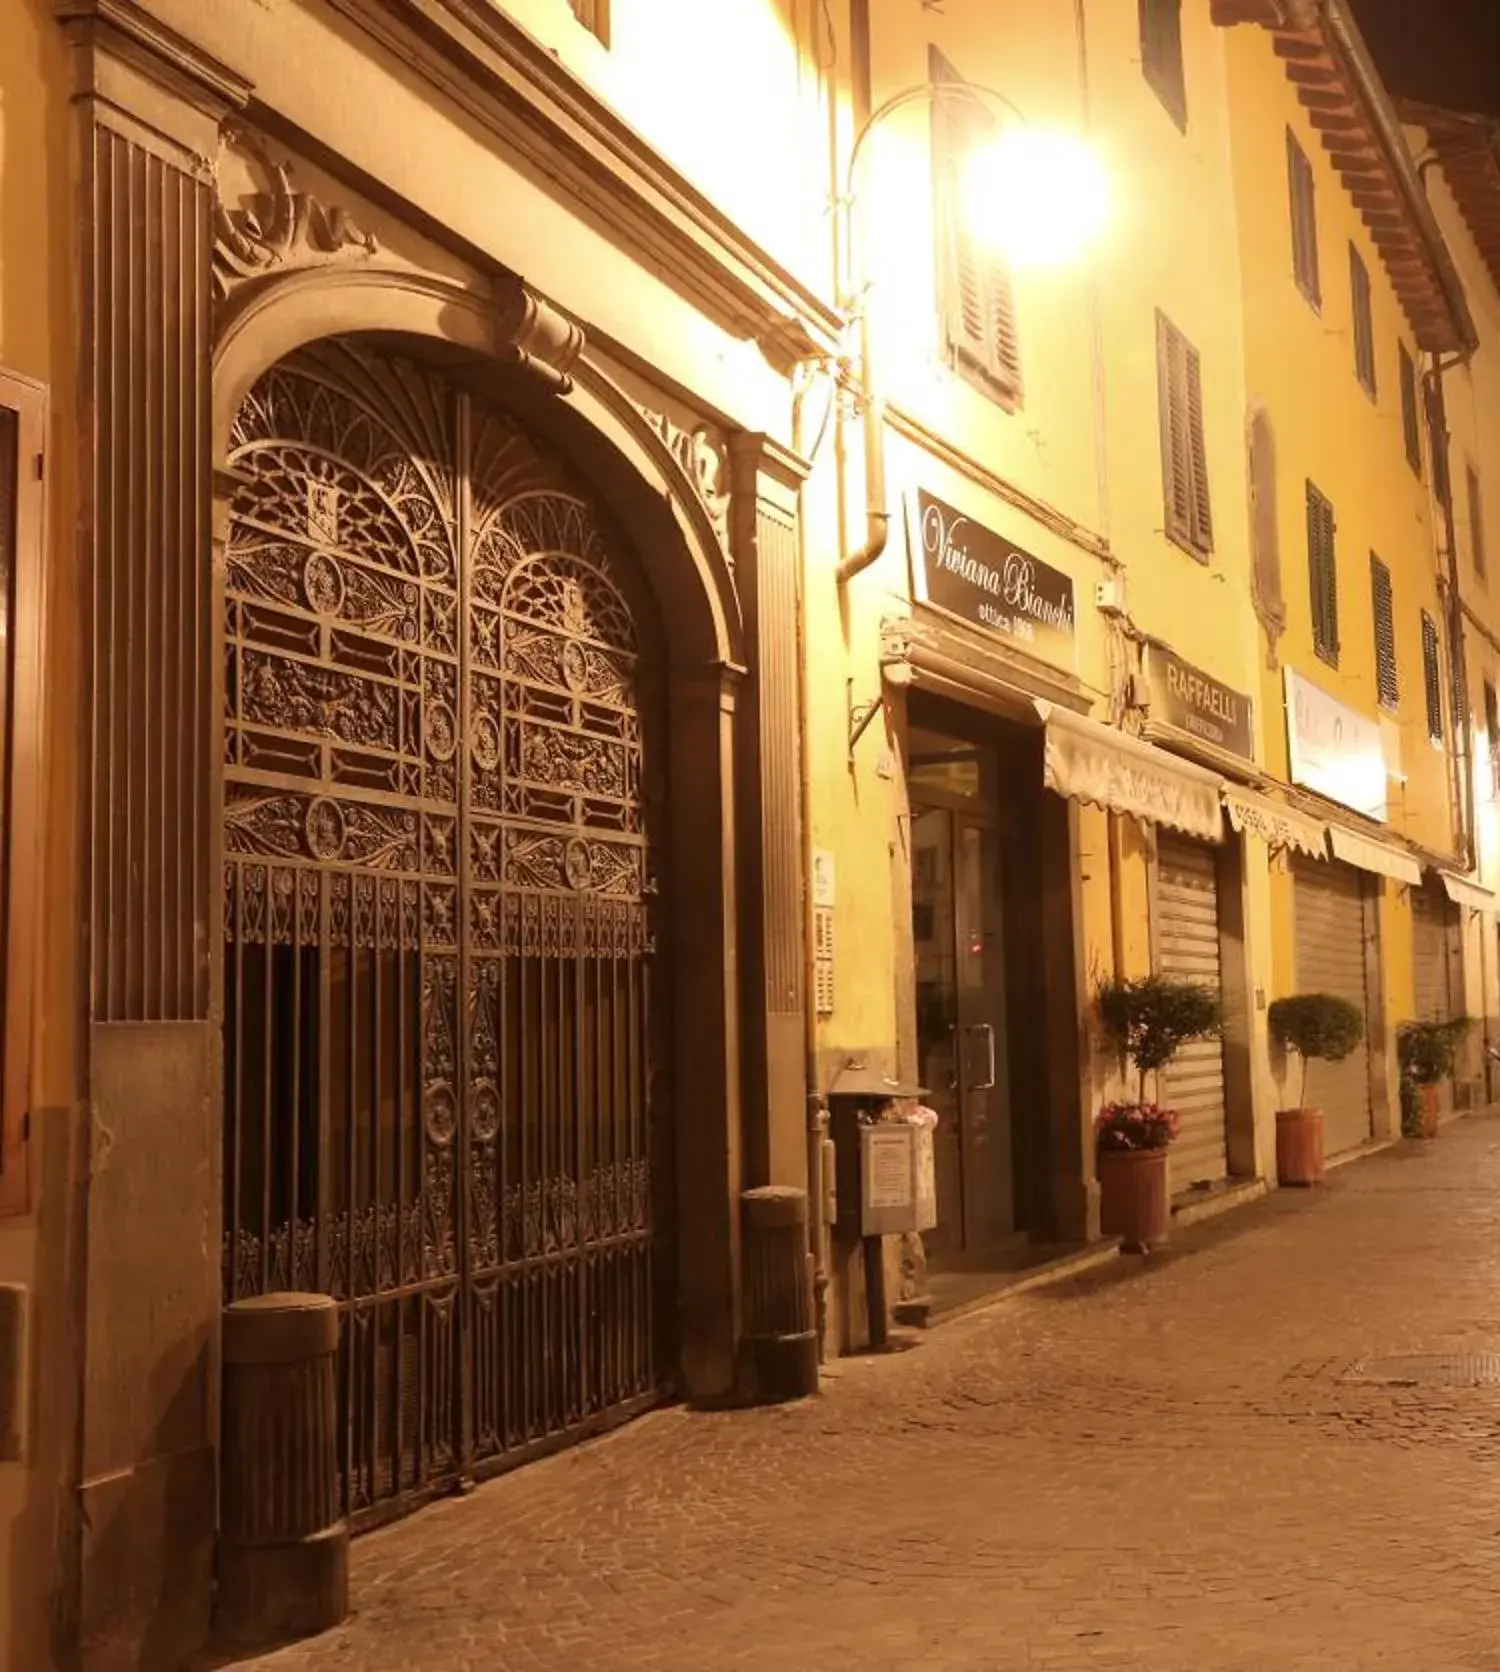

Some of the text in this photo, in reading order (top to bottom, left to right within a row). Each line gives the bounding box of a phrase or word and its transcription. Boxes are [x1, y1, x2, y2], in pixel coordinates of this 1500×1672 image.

[923, 505, 1073, 632] Viviana Bianchi
[1167, 662, 1237, 727] RAFFAELLI
